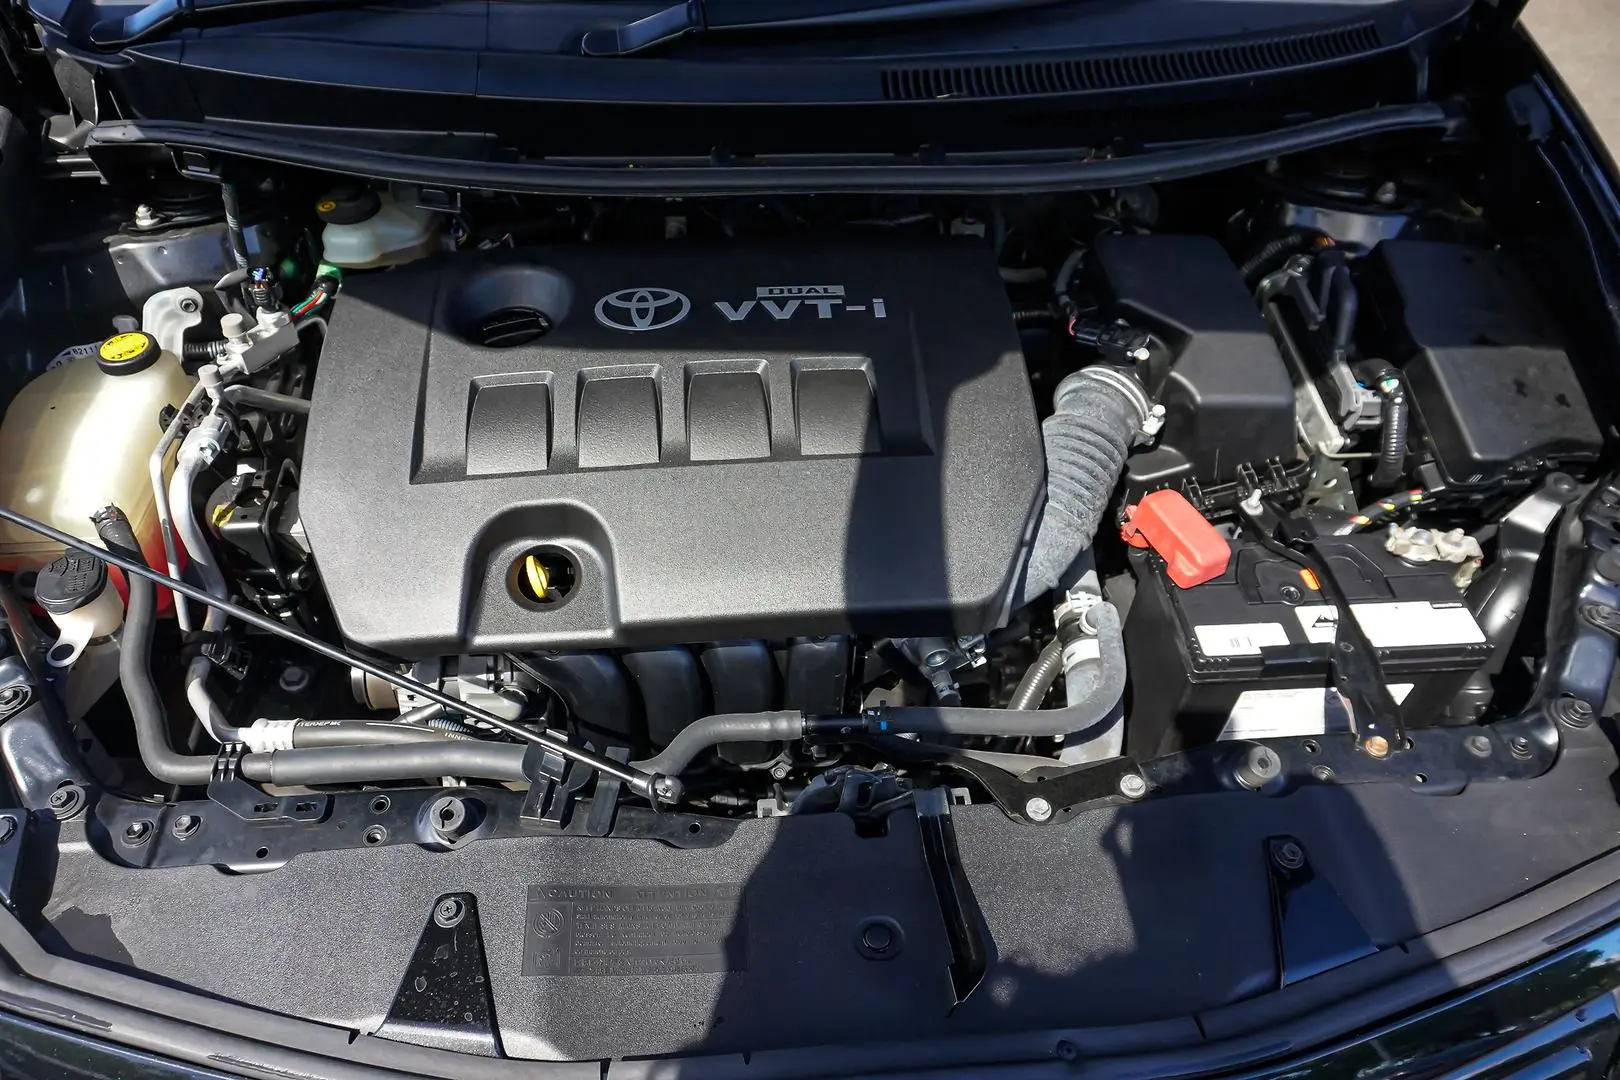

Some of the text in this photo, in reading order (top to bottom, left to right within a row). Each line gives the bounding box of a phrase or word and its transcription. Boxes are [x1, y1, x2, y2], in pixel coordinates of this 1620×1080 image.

[767, 287, 837, 296] DUAL
[714, 298, 887, 321] VVT-i
[547, 888, 612, 899] CAUTION
